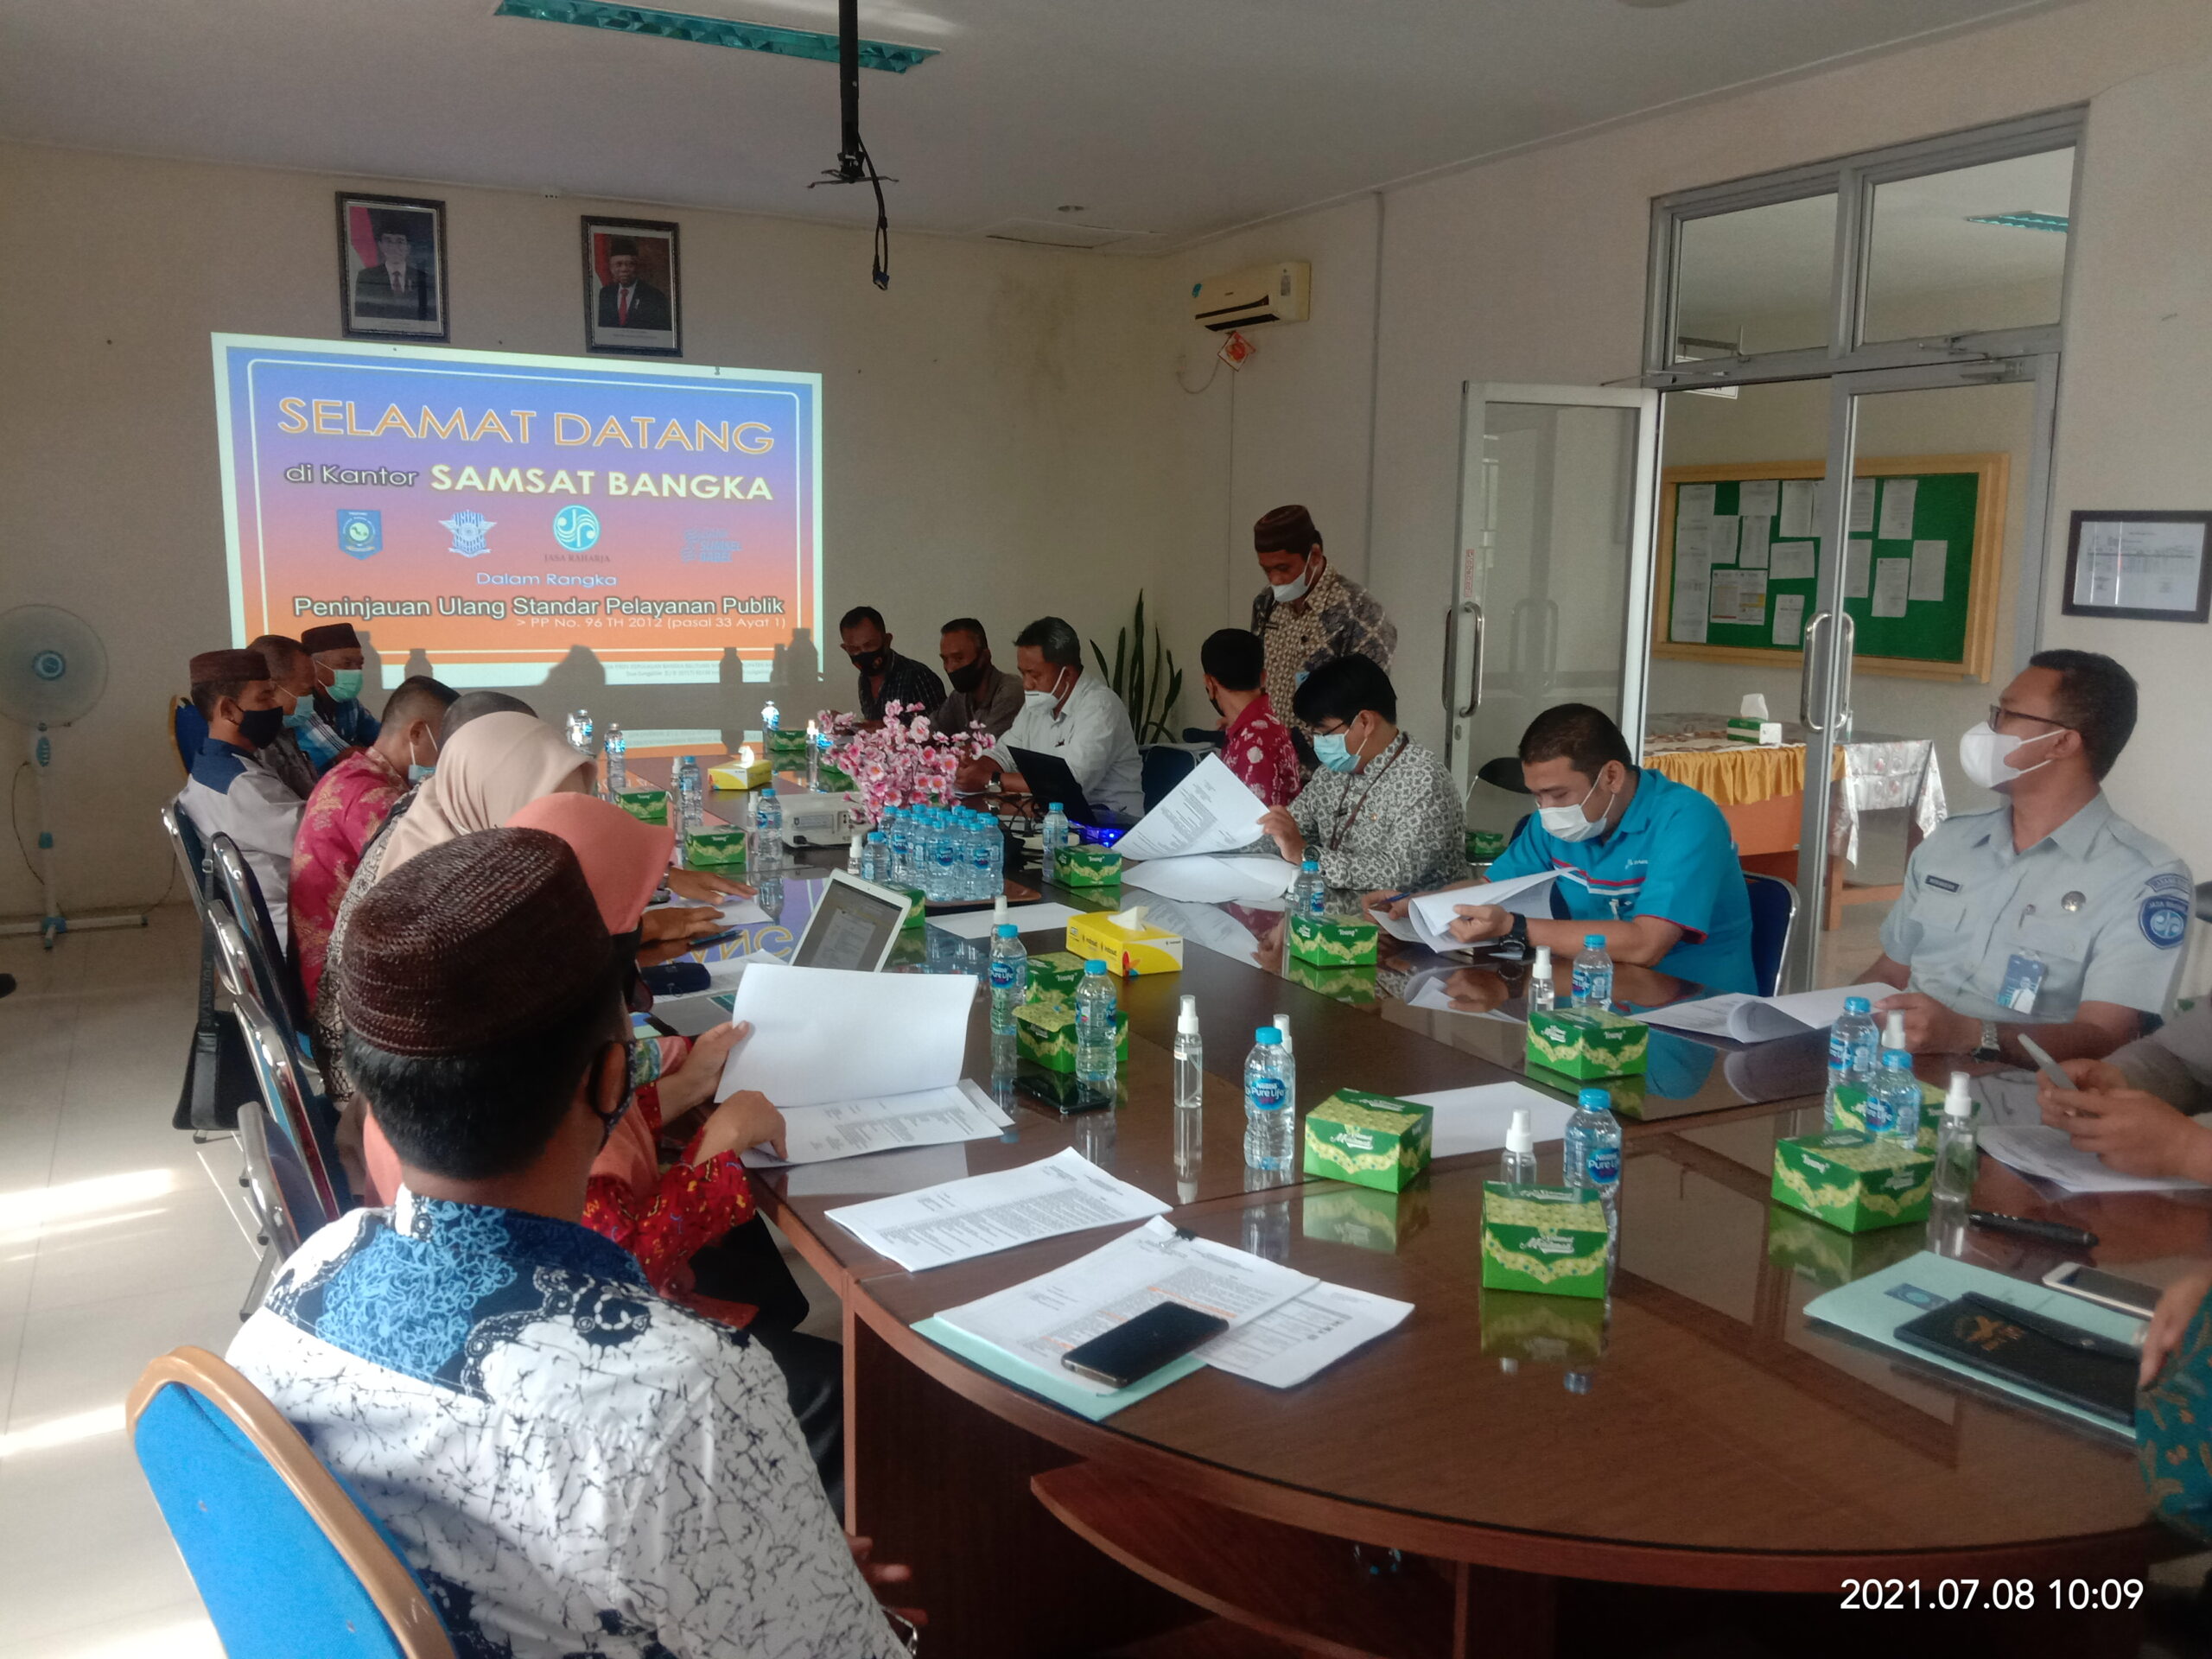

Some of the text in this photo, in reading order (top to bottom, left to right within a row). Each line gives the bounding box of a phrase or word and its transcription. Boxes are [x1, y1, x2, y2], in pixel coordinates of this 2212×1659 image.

[277, 397, 774, 454] SELAMAT DATANG
[285, 464, 773, 500] di Kantor SAMSAT BANGKA
[477, 572, 618, 588] Dalam Rangka
[293, 596, 785, 620] Peninjauan Ulang Standar Pelayanan Publik
[531, 619, 550, 628] PP
[555, 619, 581, 628] No.
[585, 619, 603, 628] 96
[606, 619, 625, 628] TH
[628, 618, 663, 628] 2012
[666, 617, 712, 630] (pasal
[715, 618, 733, 627] 33
[735, 618, 770, 630] Ayat
[1251, 1086, 1285, 1100] Pure Life
[1588, 1160, 1606, 1169] Pure
